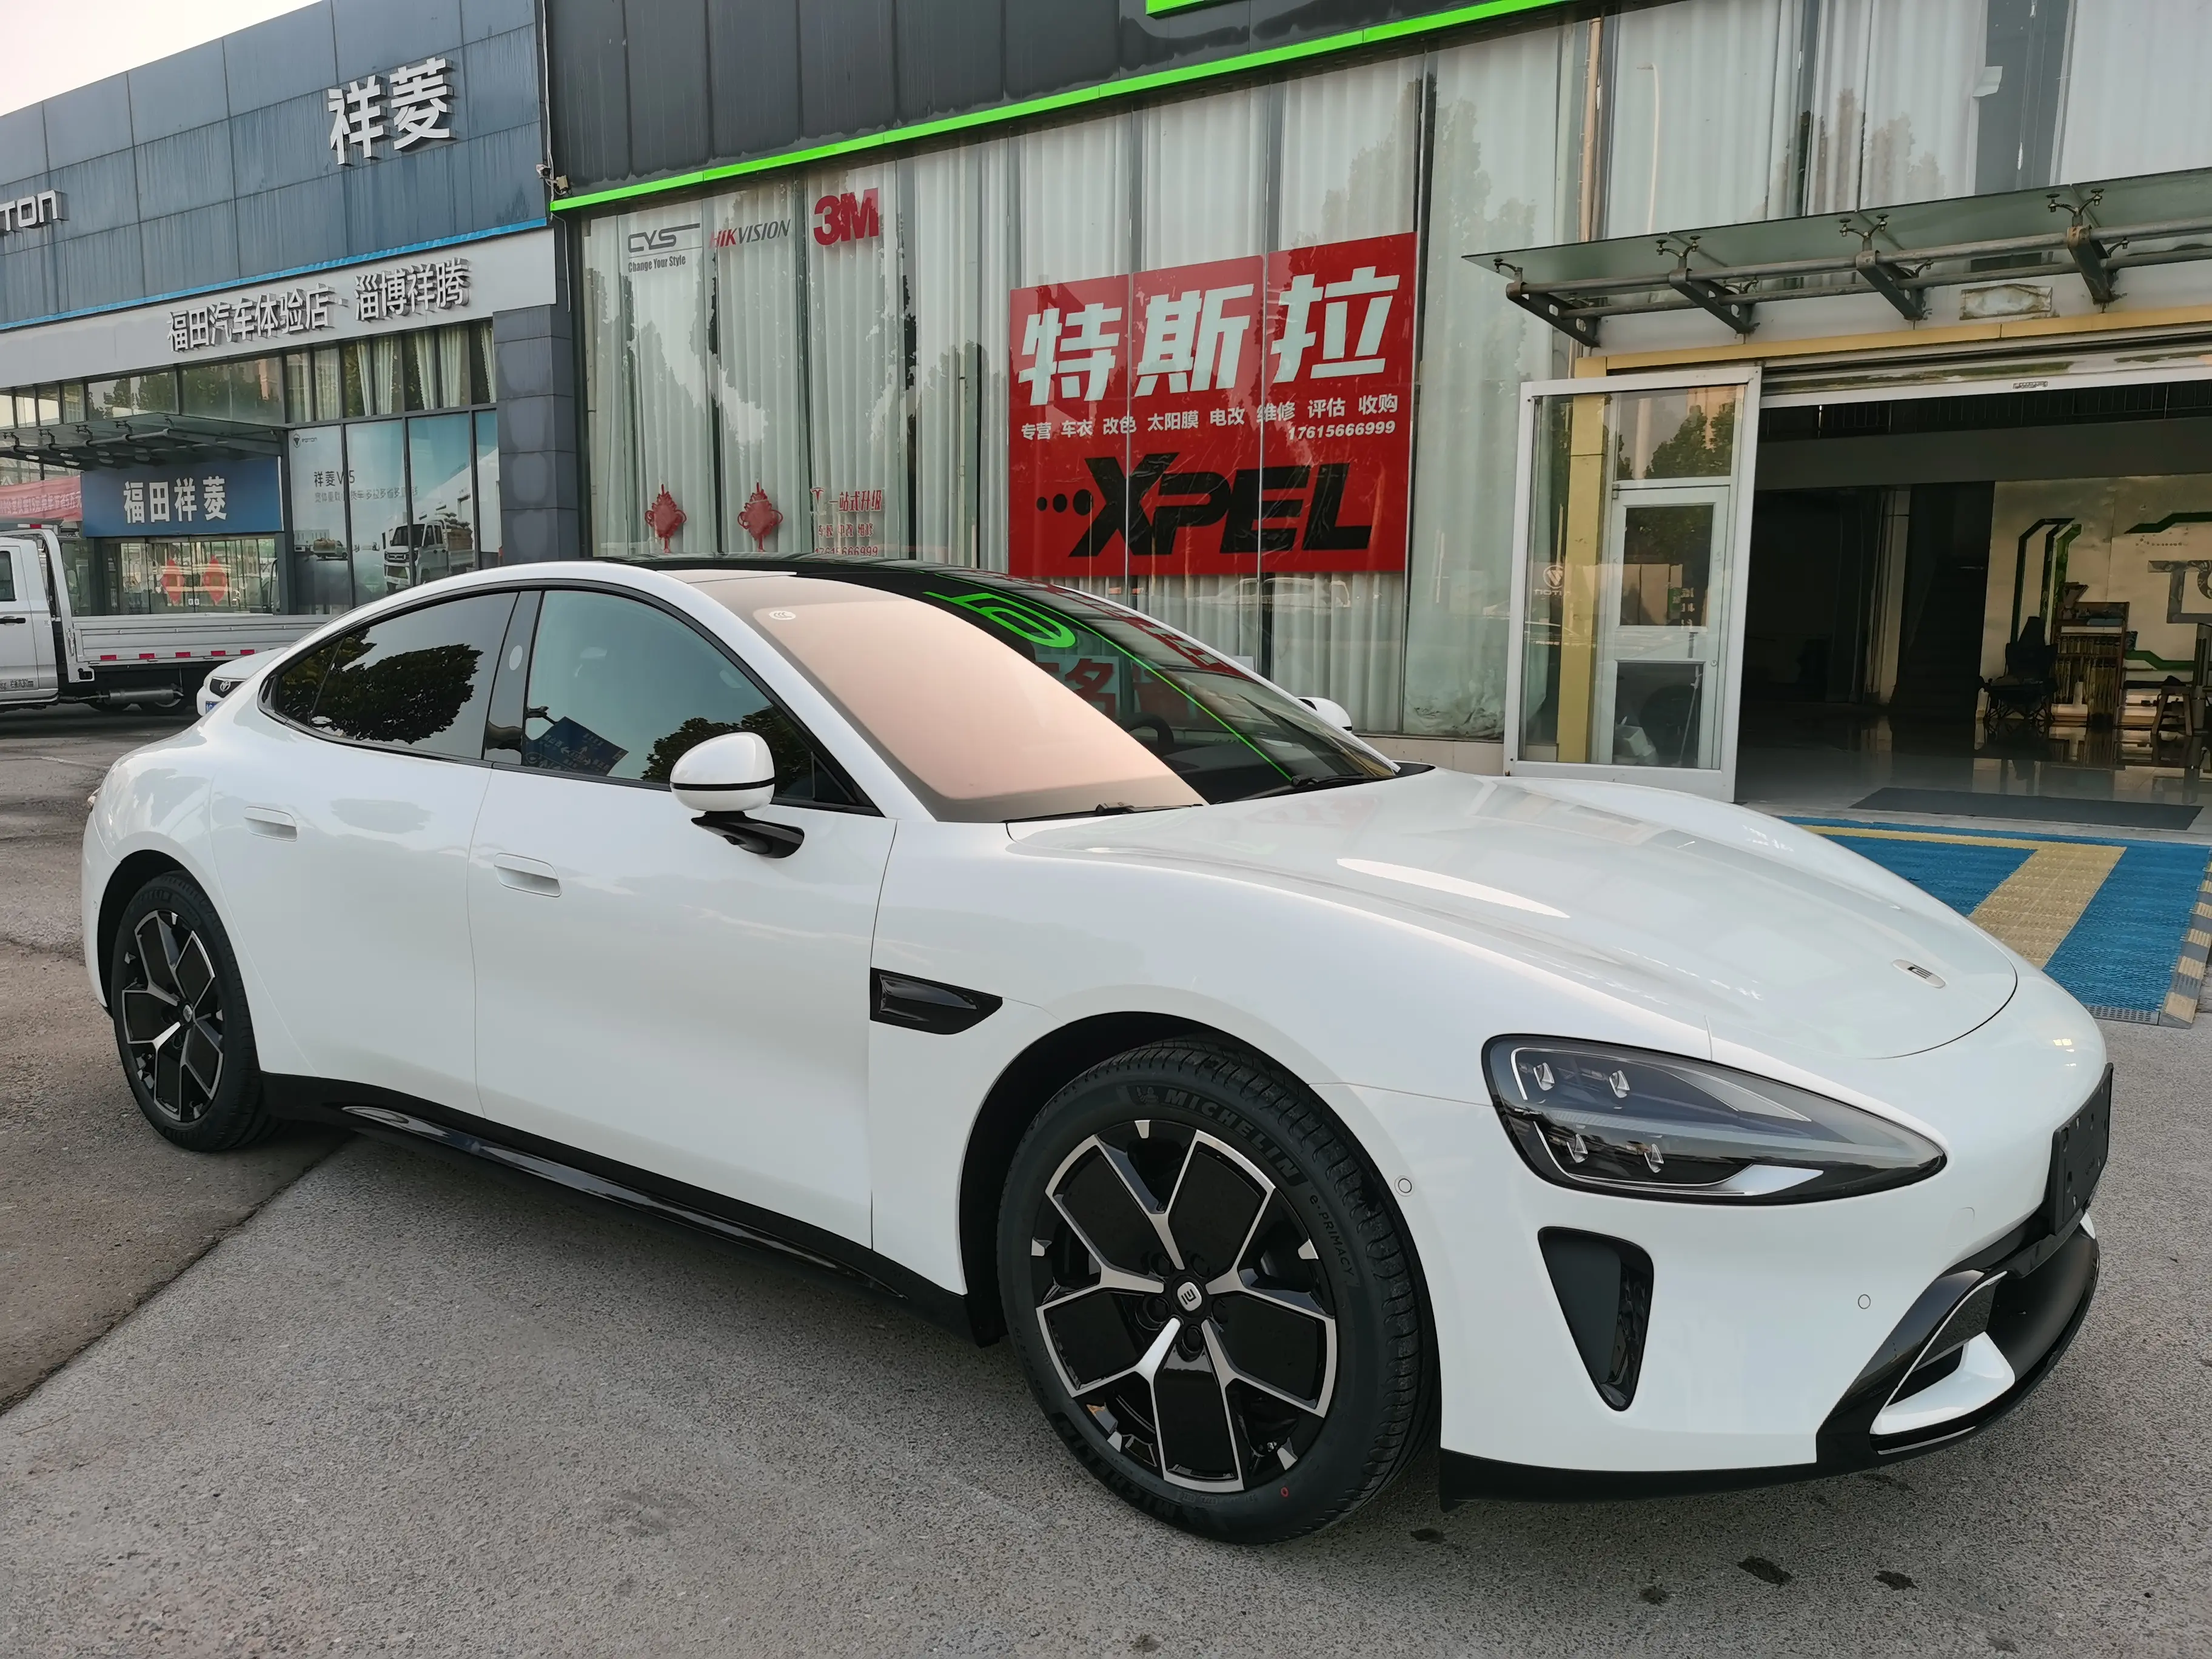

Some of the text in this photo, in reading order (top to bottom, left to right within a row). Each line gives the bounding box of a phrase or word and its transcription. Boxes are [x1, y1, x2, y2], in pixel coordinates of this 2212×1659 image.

[328, 57, 450, 165] 祥菱
[628, 223, 700, 253] CYS
[709, 219, 790, 249] HIKVISION
[814, 187, 879, 246] 3M
[628, 254, 686, 273] Change Your Style
[1018, 266, 1400, 406] 特斯拉
[1021, 393, 1398, 441] 专营 车衣 改色 太阳膜 电改 维修 评估 收购
[1287, 421, 1396, 441] 17615666999
[123, 475, 227, 524] 福田祥菱
[829, 490, 882, 511] 一站式升级
[1070, 451, 1372, 558] XPEL
[1164, 1088, 1299, 1181] MICHELIN
